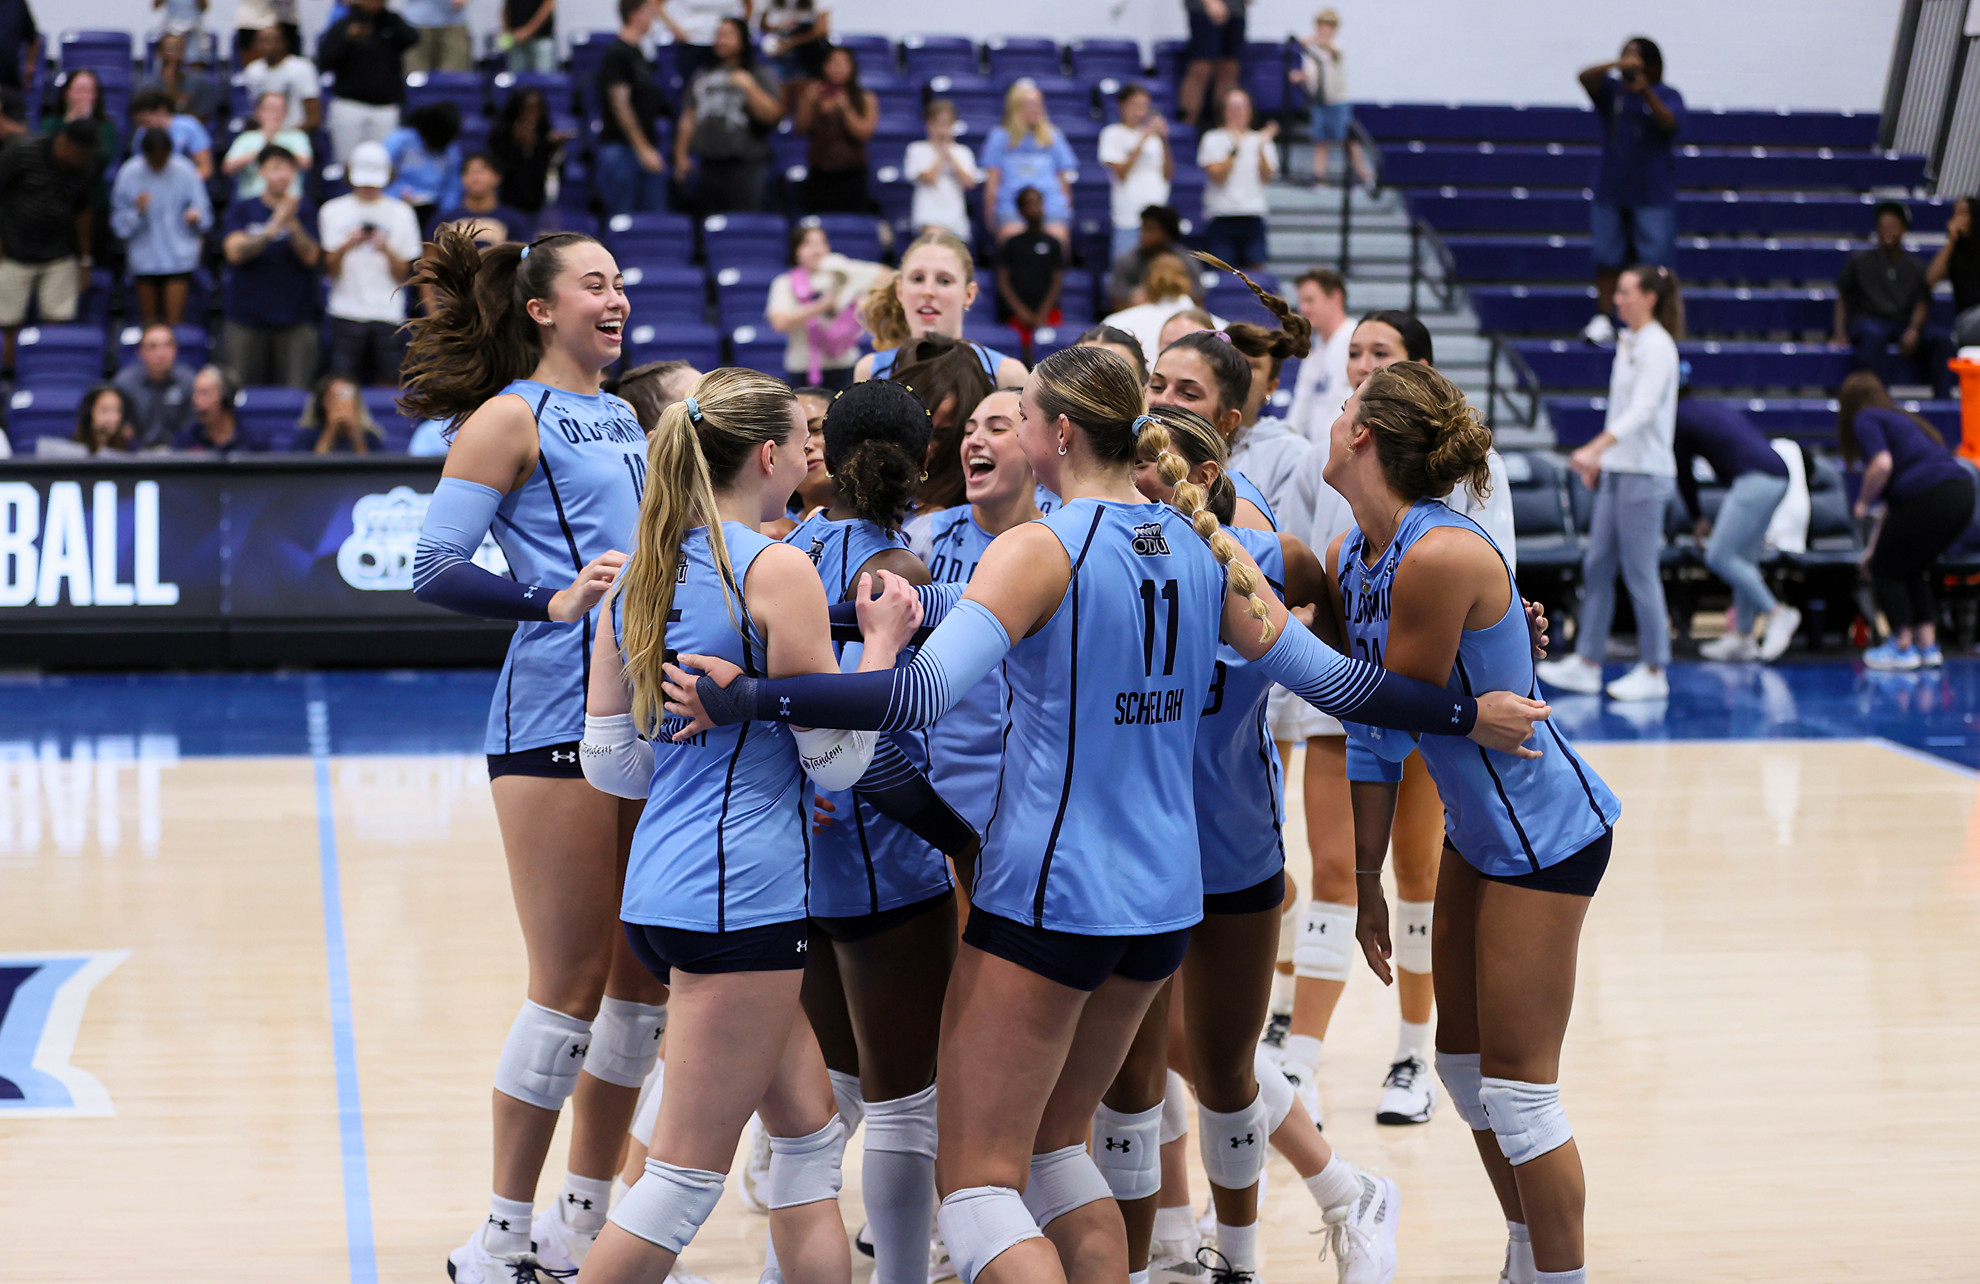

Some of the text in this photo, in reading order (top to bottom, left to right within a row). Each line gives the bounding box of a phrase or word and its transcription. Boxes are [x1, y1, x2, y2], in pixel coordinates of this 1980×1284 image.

[0, 480, 180, 607] BALL
[1131, 537, 1171, 556] ODU
[1139, 578, 1179, 677] 11
[1114, 688, 1185, 725] SCHELAH
